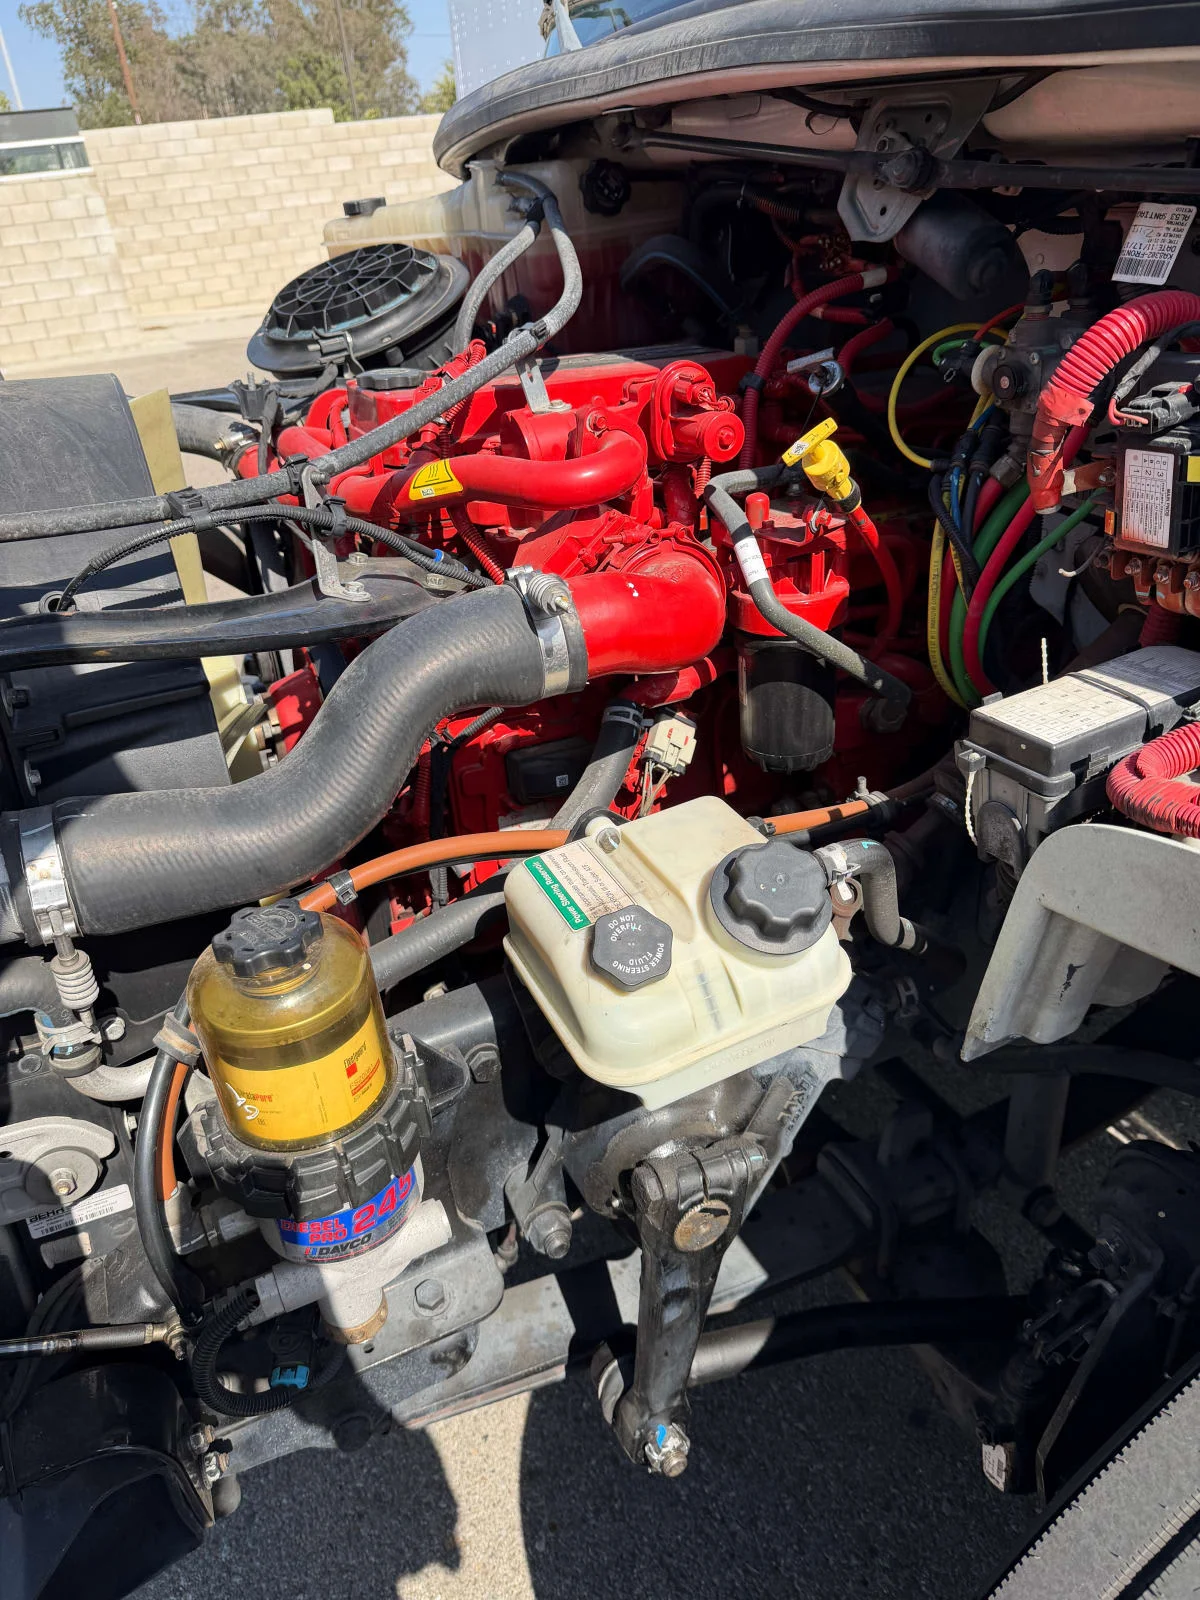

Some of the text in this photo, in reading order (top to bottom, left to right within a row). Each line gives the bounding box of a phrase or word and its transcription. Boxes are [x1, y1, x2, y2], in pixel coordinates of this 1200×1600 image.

[531, 861, 584, 924] Power Steering Reservoir
[608, 920, 619, 930] DO
[610, 923, 642, 942] OVERFILL
[612, 943, 665, 974] POWER STEERING
[629, 952, 653, 966] FLUID
[352, 1171, 411, 1235] 245
[281, 1218, 345, 1233] DIESEL
[309, 1228, 348, 1245] PRO
[319, 1232, 372, 1256] DAVCO
